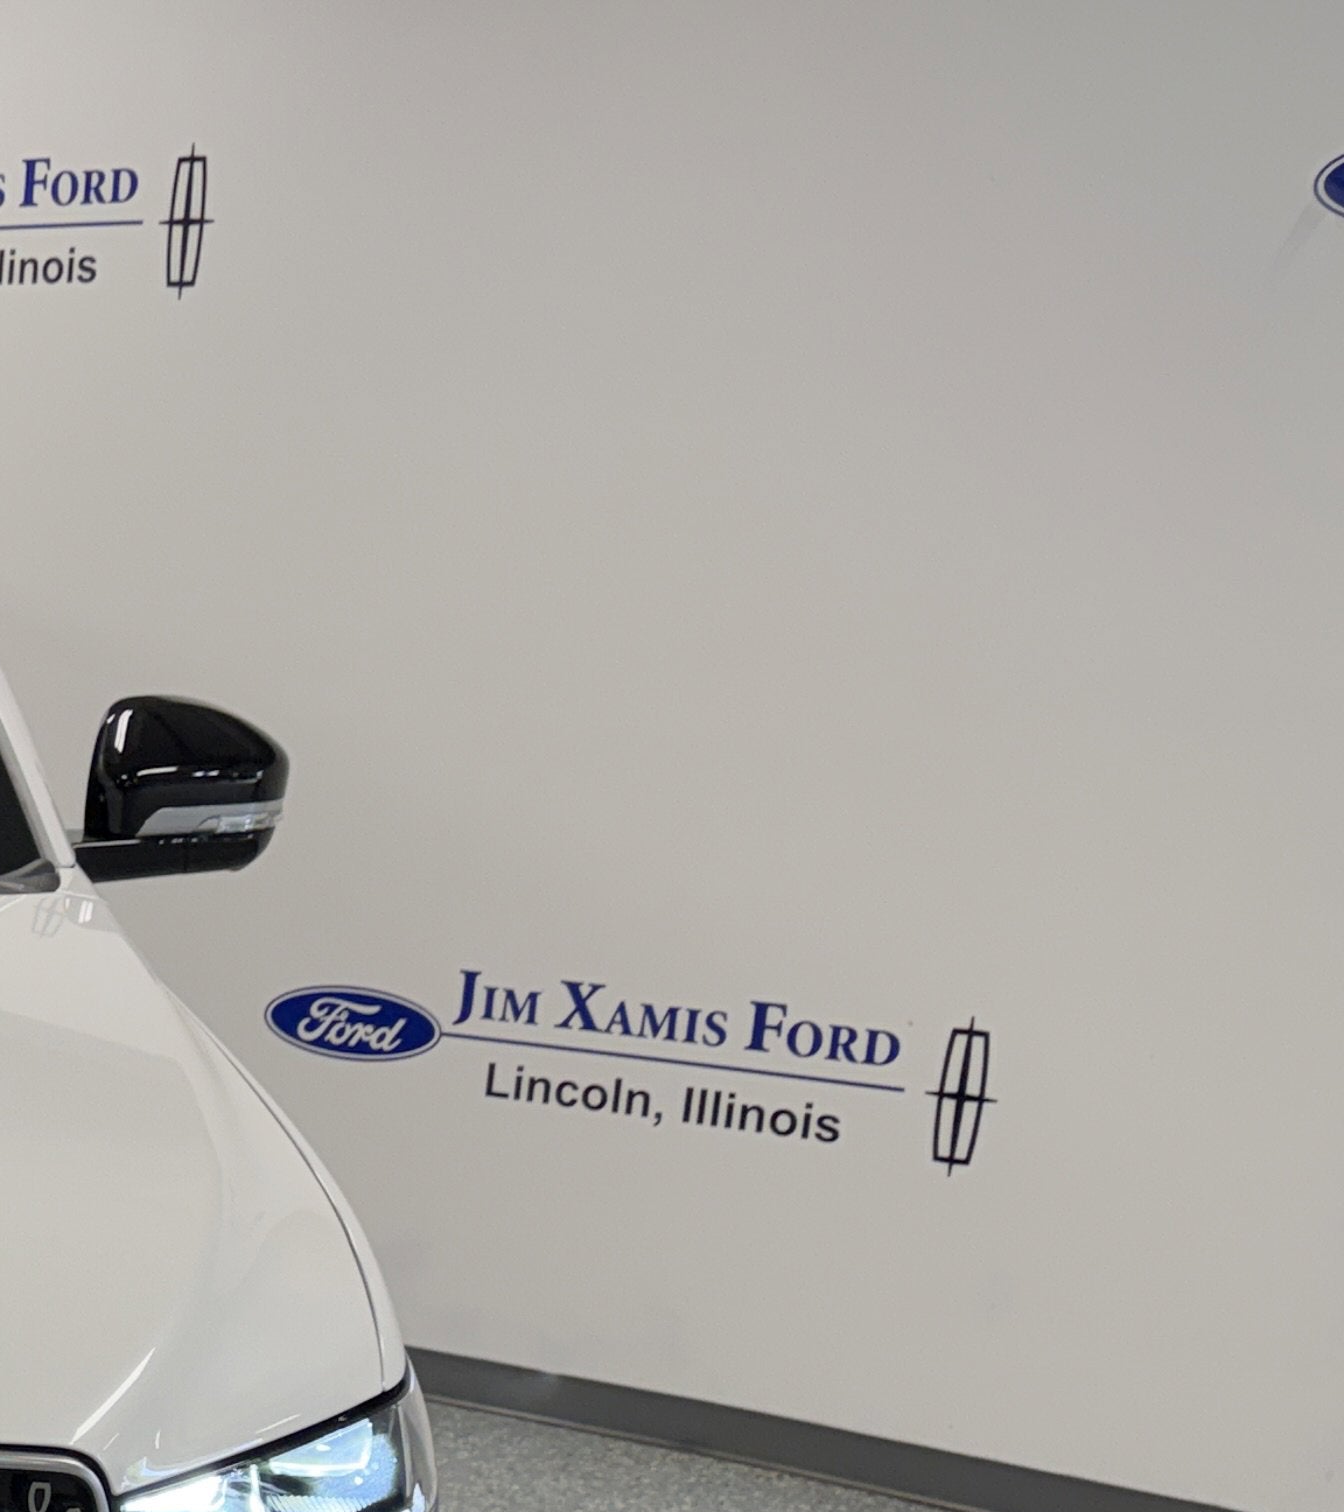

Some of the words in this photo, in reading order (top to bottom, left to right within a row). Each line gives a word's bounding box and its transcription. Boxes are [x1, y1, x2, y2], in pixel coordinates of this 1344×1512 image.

[19, 157, 139, 208] FORD
[296, 996, 404, 1054] Ford
[453, 969, 541, 1028] JIM
[553, 980, 729, 1048] XAMIS
[743, 1000, 901, 1067] FORD
[483, 1061, 664, 1126] Lincoln,
[681, 1086, 841, 1144] Illinois
